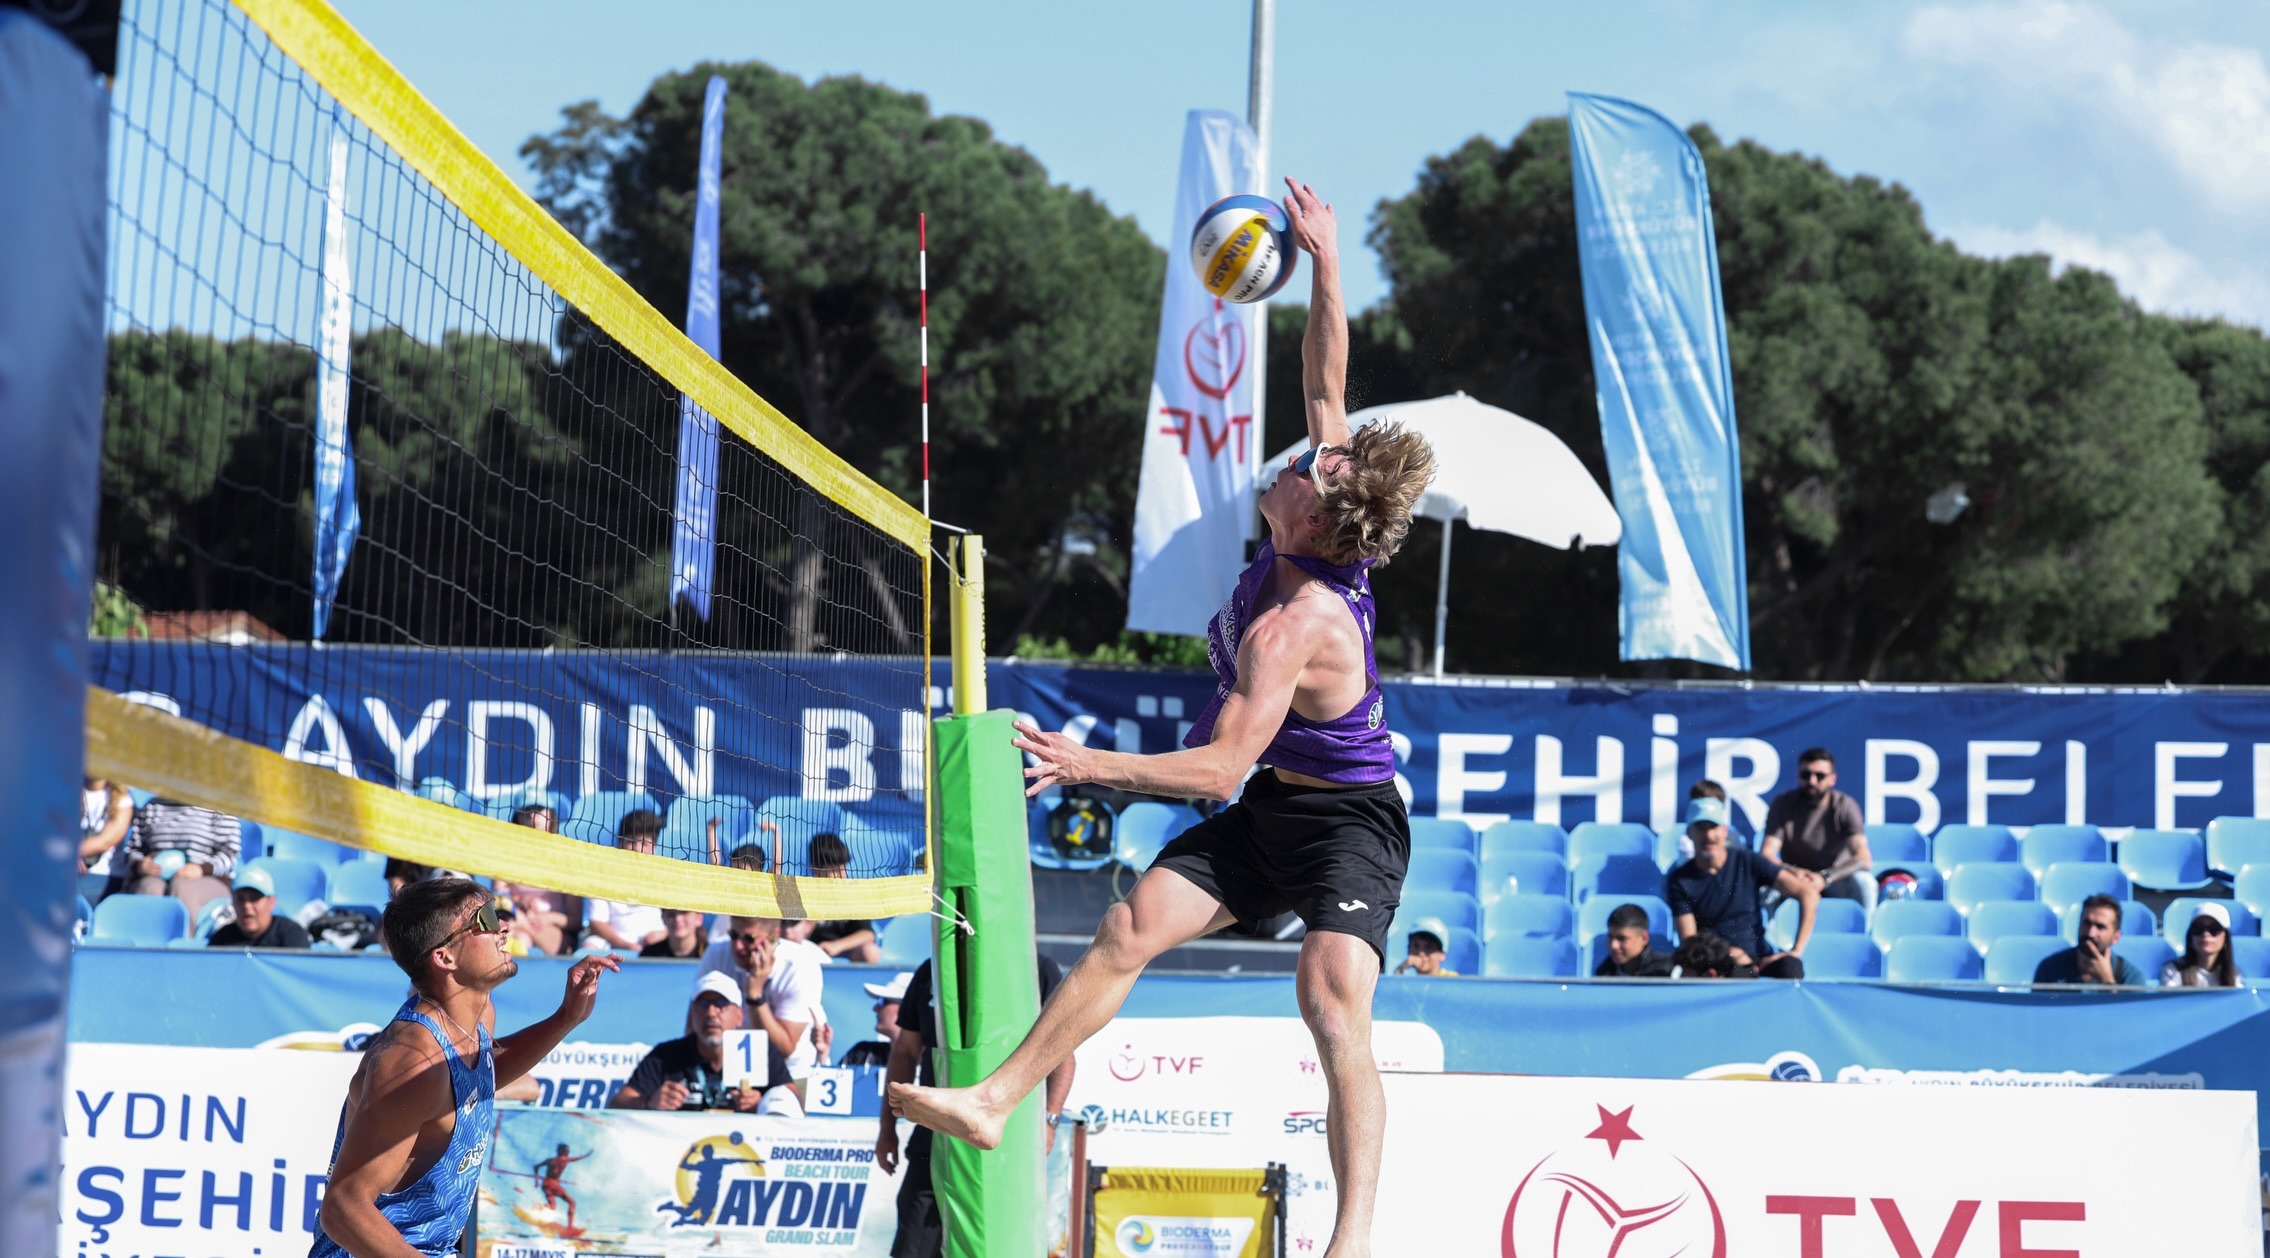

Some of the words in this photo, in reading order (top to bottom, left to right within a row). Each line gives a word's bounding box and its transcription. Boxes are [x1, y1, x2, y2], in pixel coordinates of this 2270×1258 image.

[1208, 228, 1254, 289] MIKASA
[282, 694, 716, 797] AYDIN
[1864, 738, 2270, 843] BELE
[541, 1050, 642, 1067] ÜYÜKŞEHİ
[737, 1033, 752, 1073] 1
[1153, 1056, 1203, 1076] TVF
[820, 1079, 837, 1107] 3
[60, 1089, 247, 1144] YDIN
[1112, 1108, 1233, 1128] HALKEGEET
[770, 1146, 843, 1162] BIODERMA
[846, 1148, 875, 1163] PRO
[784, 1163, 829, 1179] BEACH
[832, 1165, 871, 1180] TOUR
[715, 1179, 868, 1229] AYDIN
[765, 1230, 813, 1244] GRAND
[815, 1231, 855, 1246] SLAM
[1161, 1226, 1232, 1238] BIODERMA
